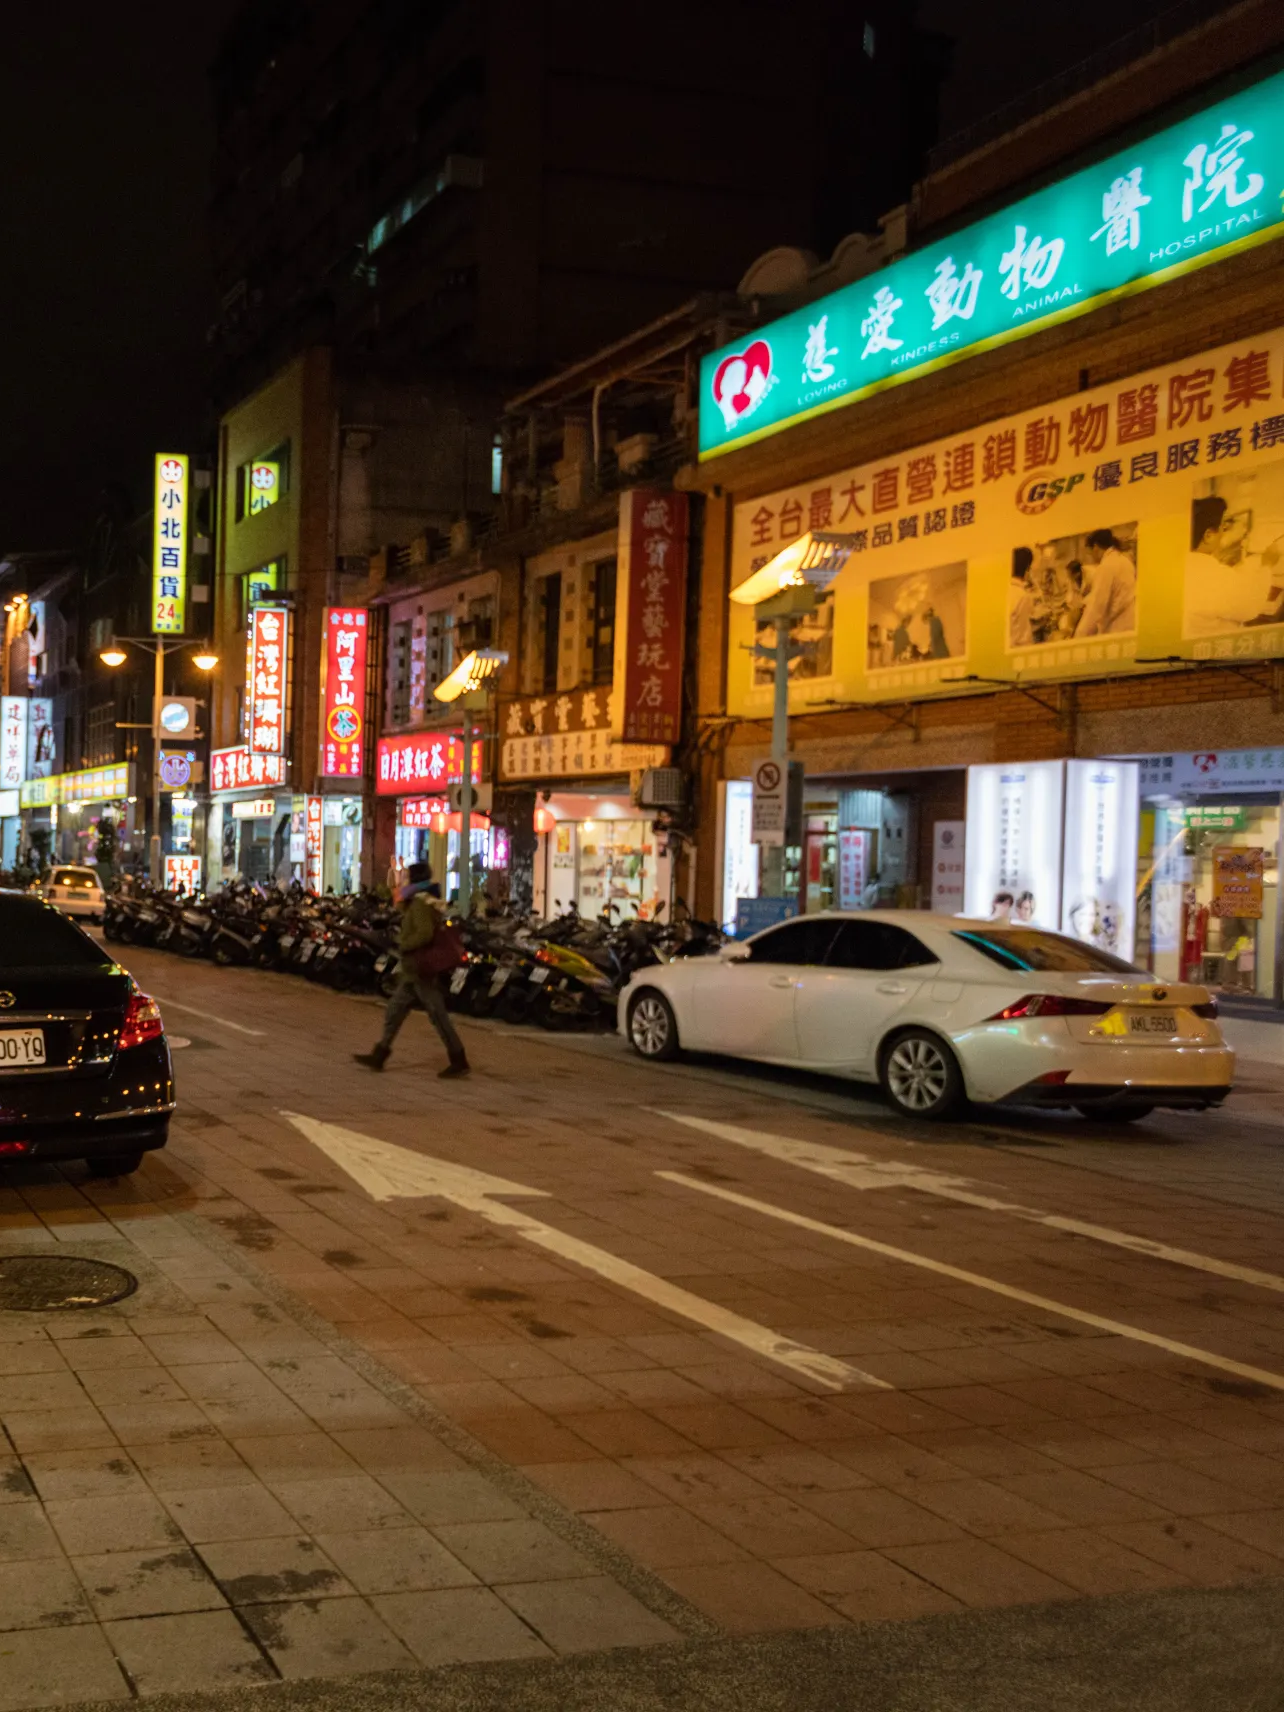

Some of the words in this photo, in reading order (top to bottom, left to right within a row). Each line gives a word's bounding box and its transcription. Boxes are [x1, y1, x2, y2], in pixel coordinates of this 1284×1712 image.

[797, 377, 848, 406] LOVING
[891, 332, 960, 366] KINDESS
[1012, 283, 1083, 318] ANIMAL
[1149, 208, 1265, 262] HOSPITAL
[802, 125, 1264, 383] 慈愛動物醫院
[160, 488, 181, 599] 小北百貨
[1028, 473, 1085, 502] GSP
[254, 612, 280, 751] 台灣紅珊瑚
[381, 742, 445, 782] 日月潭紅茶
